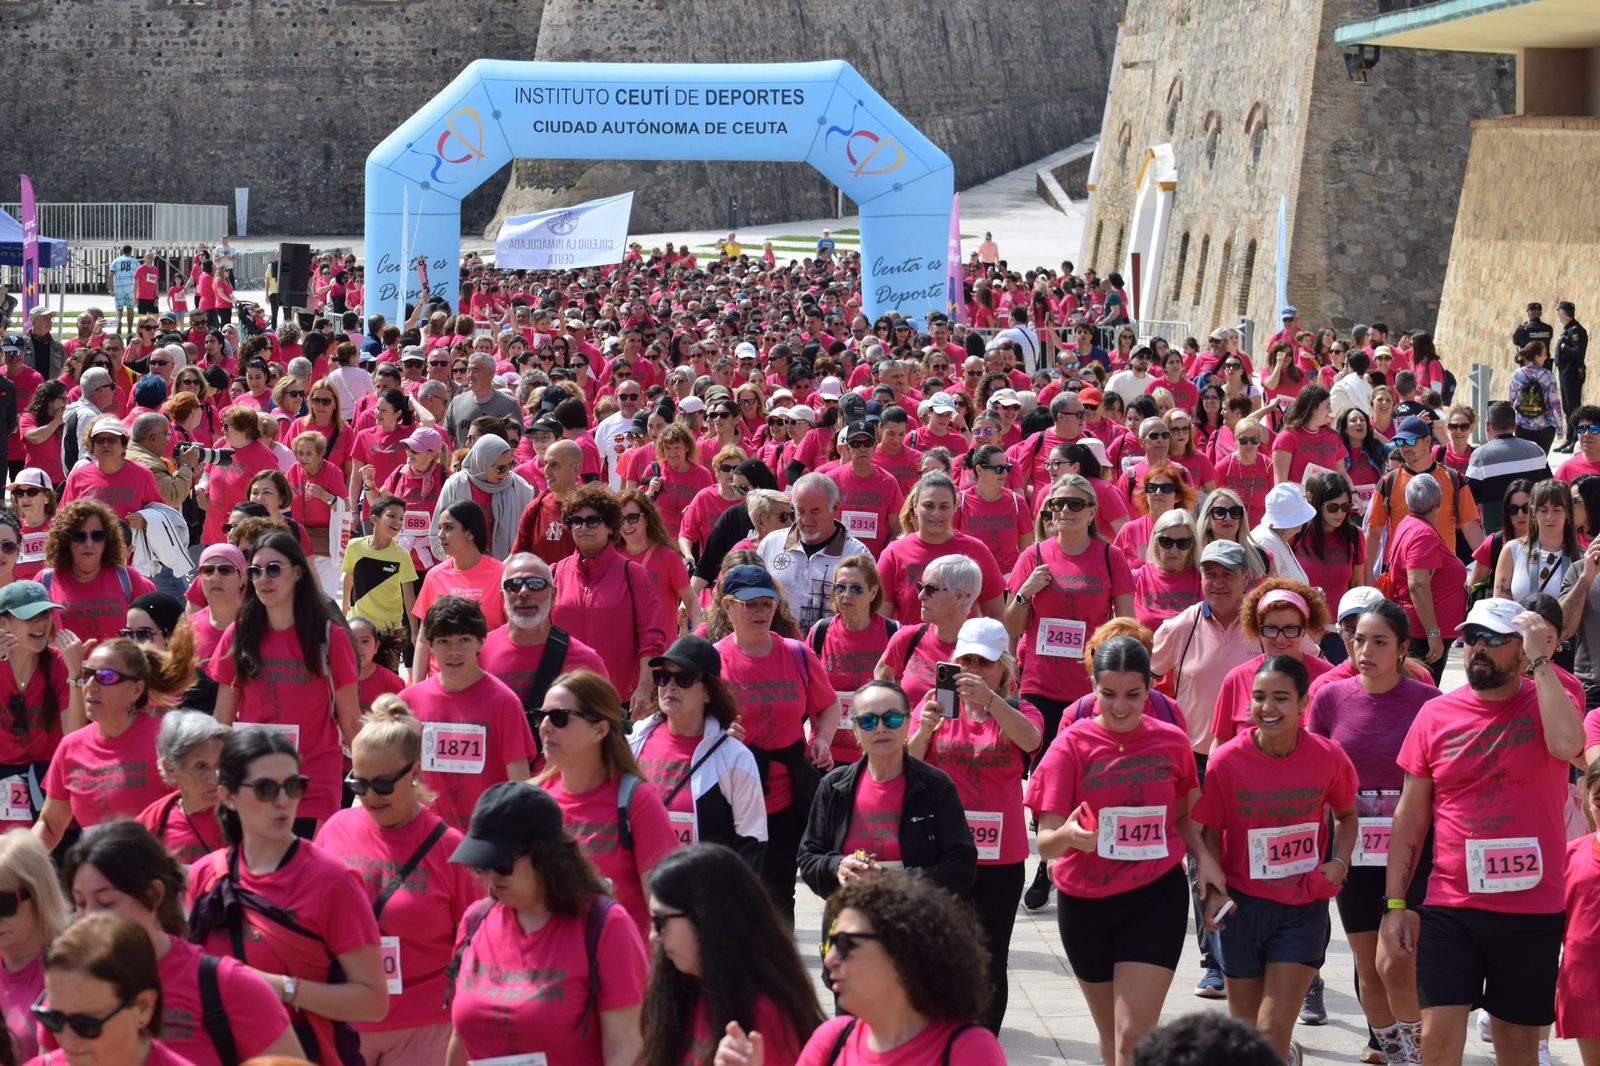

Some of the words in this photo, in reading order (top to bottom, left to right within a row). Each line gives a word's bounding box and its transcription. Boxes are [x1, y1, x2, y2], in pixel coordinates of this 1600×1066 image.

[515, 87, 609, 105] INSTITUTO
[615, 86, 669, 105] CEUTÍ
[675, 89, 699, 105] DE
[705, 88, 805, 105] DEPORTES
[533, 120, 597, 133] CIUDAD
[602, 119, 700, 134] AUTÓNOMA
[705, 122, 727, 135] DE
[732, 121, 788, 134] CEUTA
[433, 258, 448, 270] es
[872, 256, 922, 277] Ceuta
[928, 259, 943, 270] es
[379, 282, 449, 305] Depote
[875, 282, 945, 310] Deporte
[407, 518, 426, 528] 689
[850, 519, 876, 529] 2314
[1047, 631, 1082, 646] 2435
[438, 739, 481, 757] 1871
[1119, 824, 1161, 841] 1471
[1270, 837, 1314, 861] 1470
[1487, 854, 1538, 875] 1152
